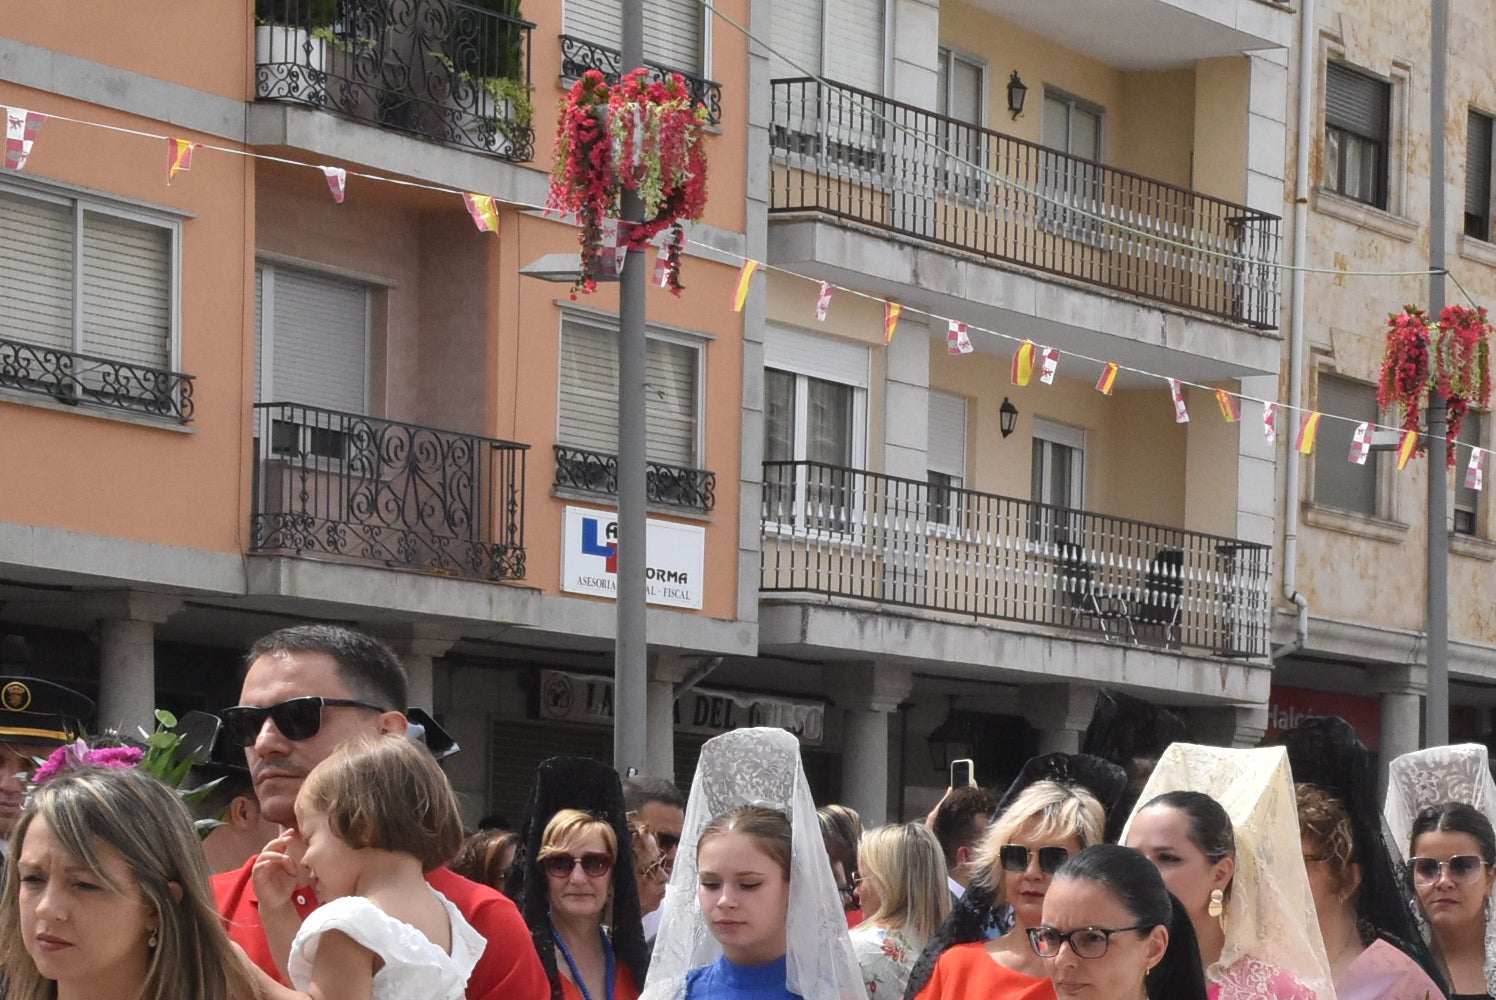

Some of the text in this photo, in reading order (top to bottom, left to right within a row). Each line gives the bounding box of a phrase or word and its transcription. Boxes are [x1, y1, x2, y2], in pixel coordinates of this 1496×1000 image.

[646, 567, 688, 584] ORMA
[577, 576, 616, 591] ASESORIA
[663, 587, 691, 600] FISCAL
[693, 695, 736, 729] DEL
